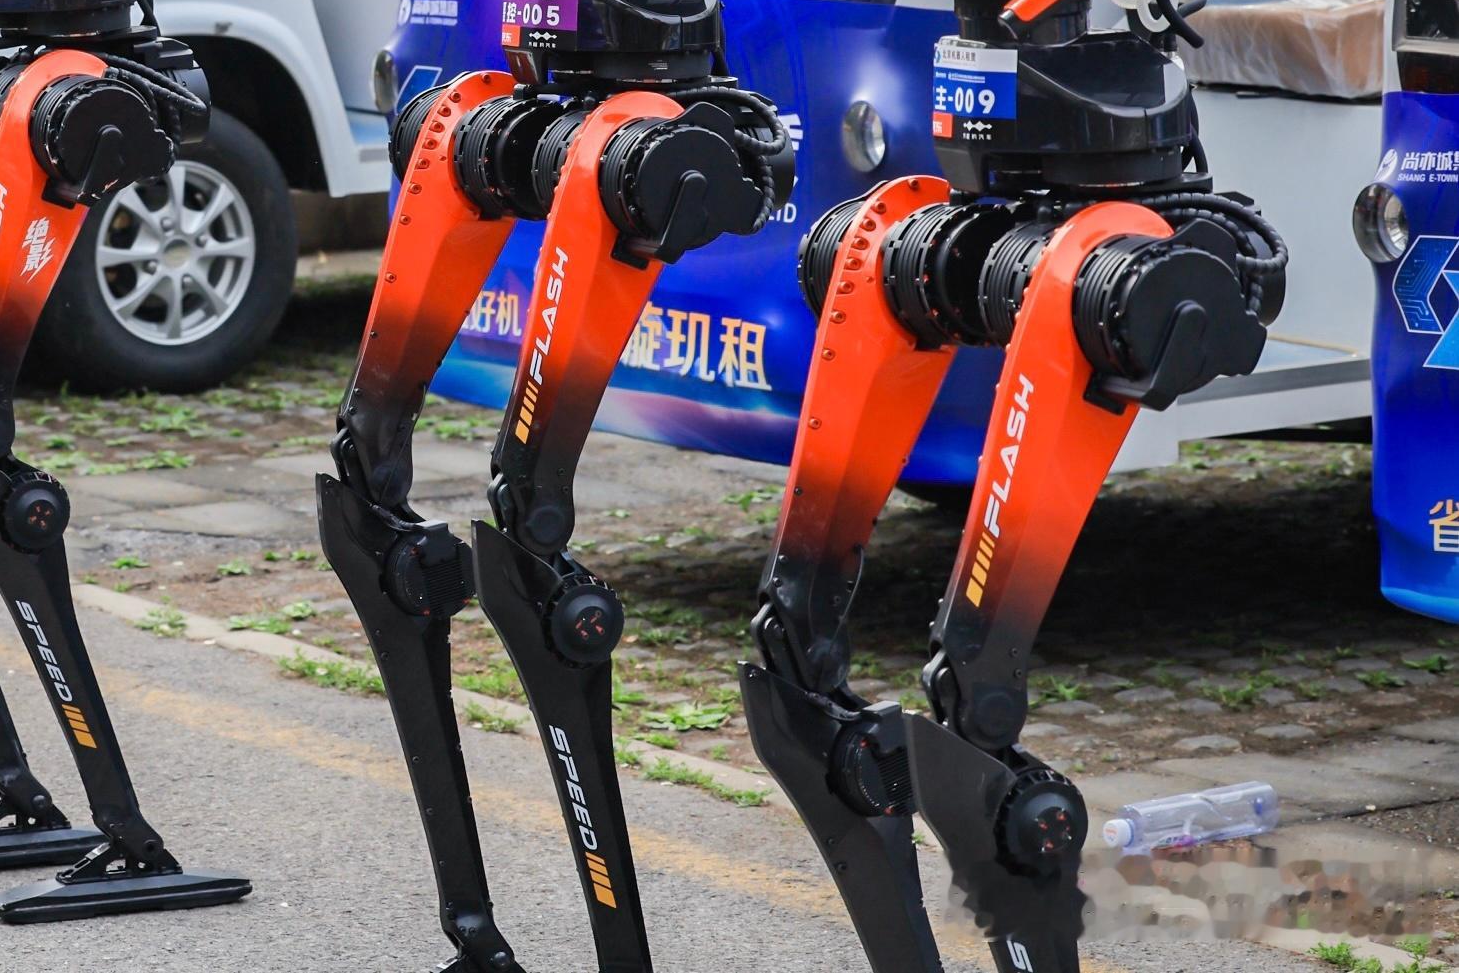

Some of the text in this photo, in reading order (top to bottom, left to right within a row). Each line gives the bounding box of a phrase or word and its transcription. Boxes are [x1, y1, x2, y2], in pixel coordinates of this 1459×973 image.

[1397, 173, 1459, 183] SHANG E-TOWN
[461, 289, 523, 338] 好机
[529, 245, 570, 386] FLASH
[984, 373, 1035, 539] FLASH
[15, 599, 74, 703] SPEED
[549, 723, 598, 852] SPEED
[1006, 939, 1034, 973] S
